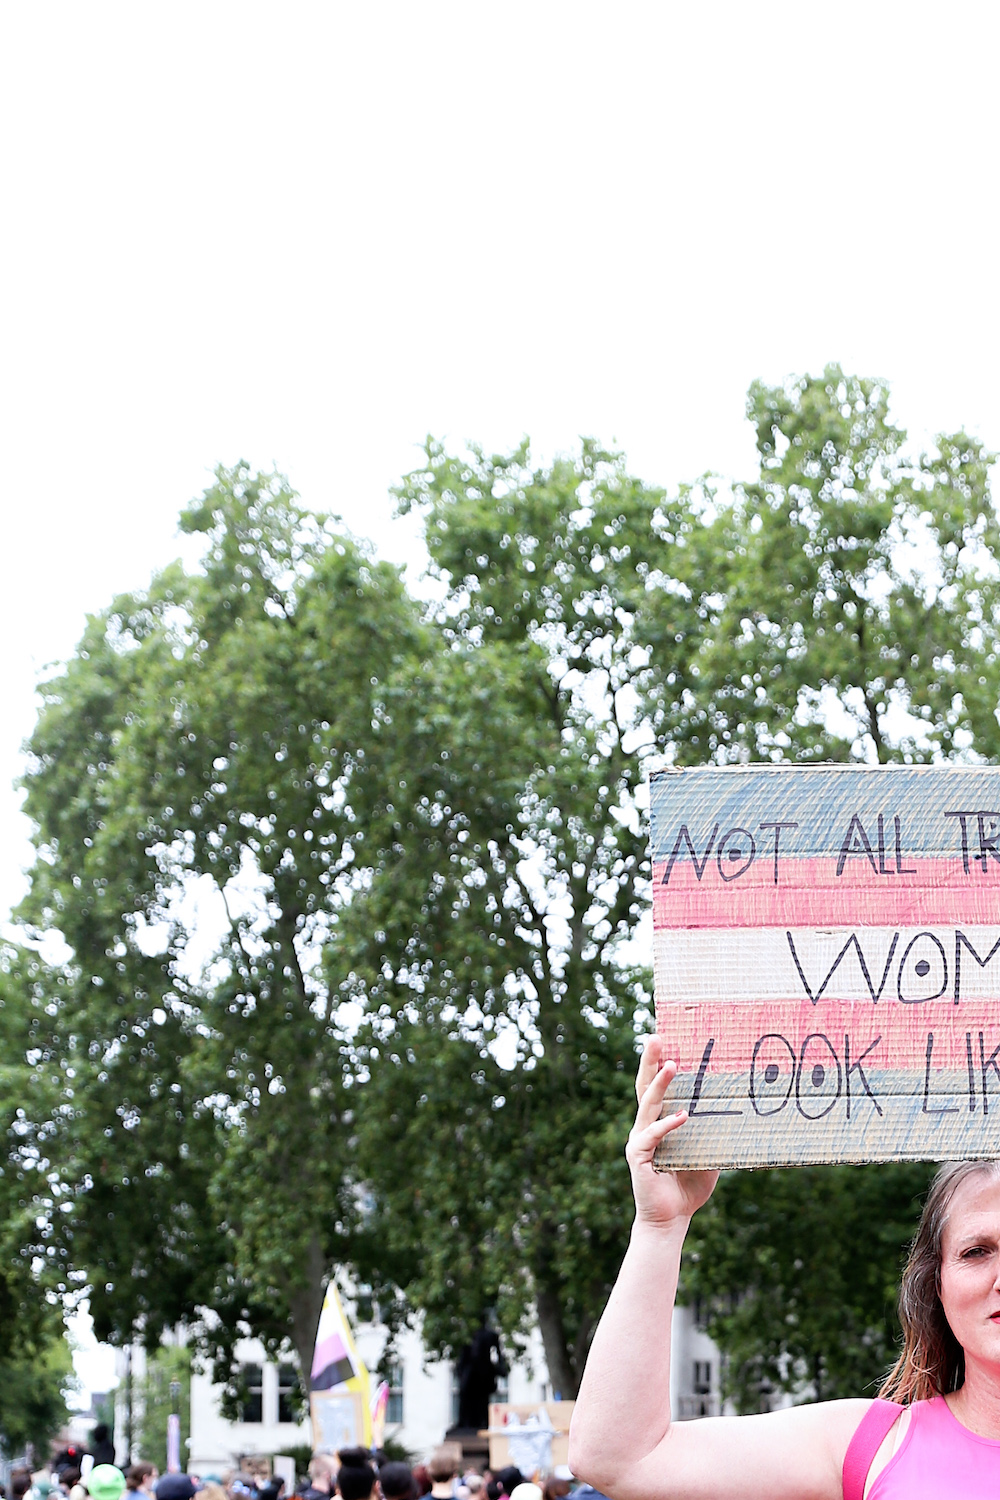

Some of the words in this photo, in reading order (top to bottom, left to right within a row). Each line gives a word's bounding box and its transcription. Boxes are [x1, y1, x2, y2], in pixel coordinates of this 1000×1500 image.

[661, 822, 799, 885] NOT
[835, 812, 917, 877] ALL
[687, 1032, 884, 1121] LOOK
